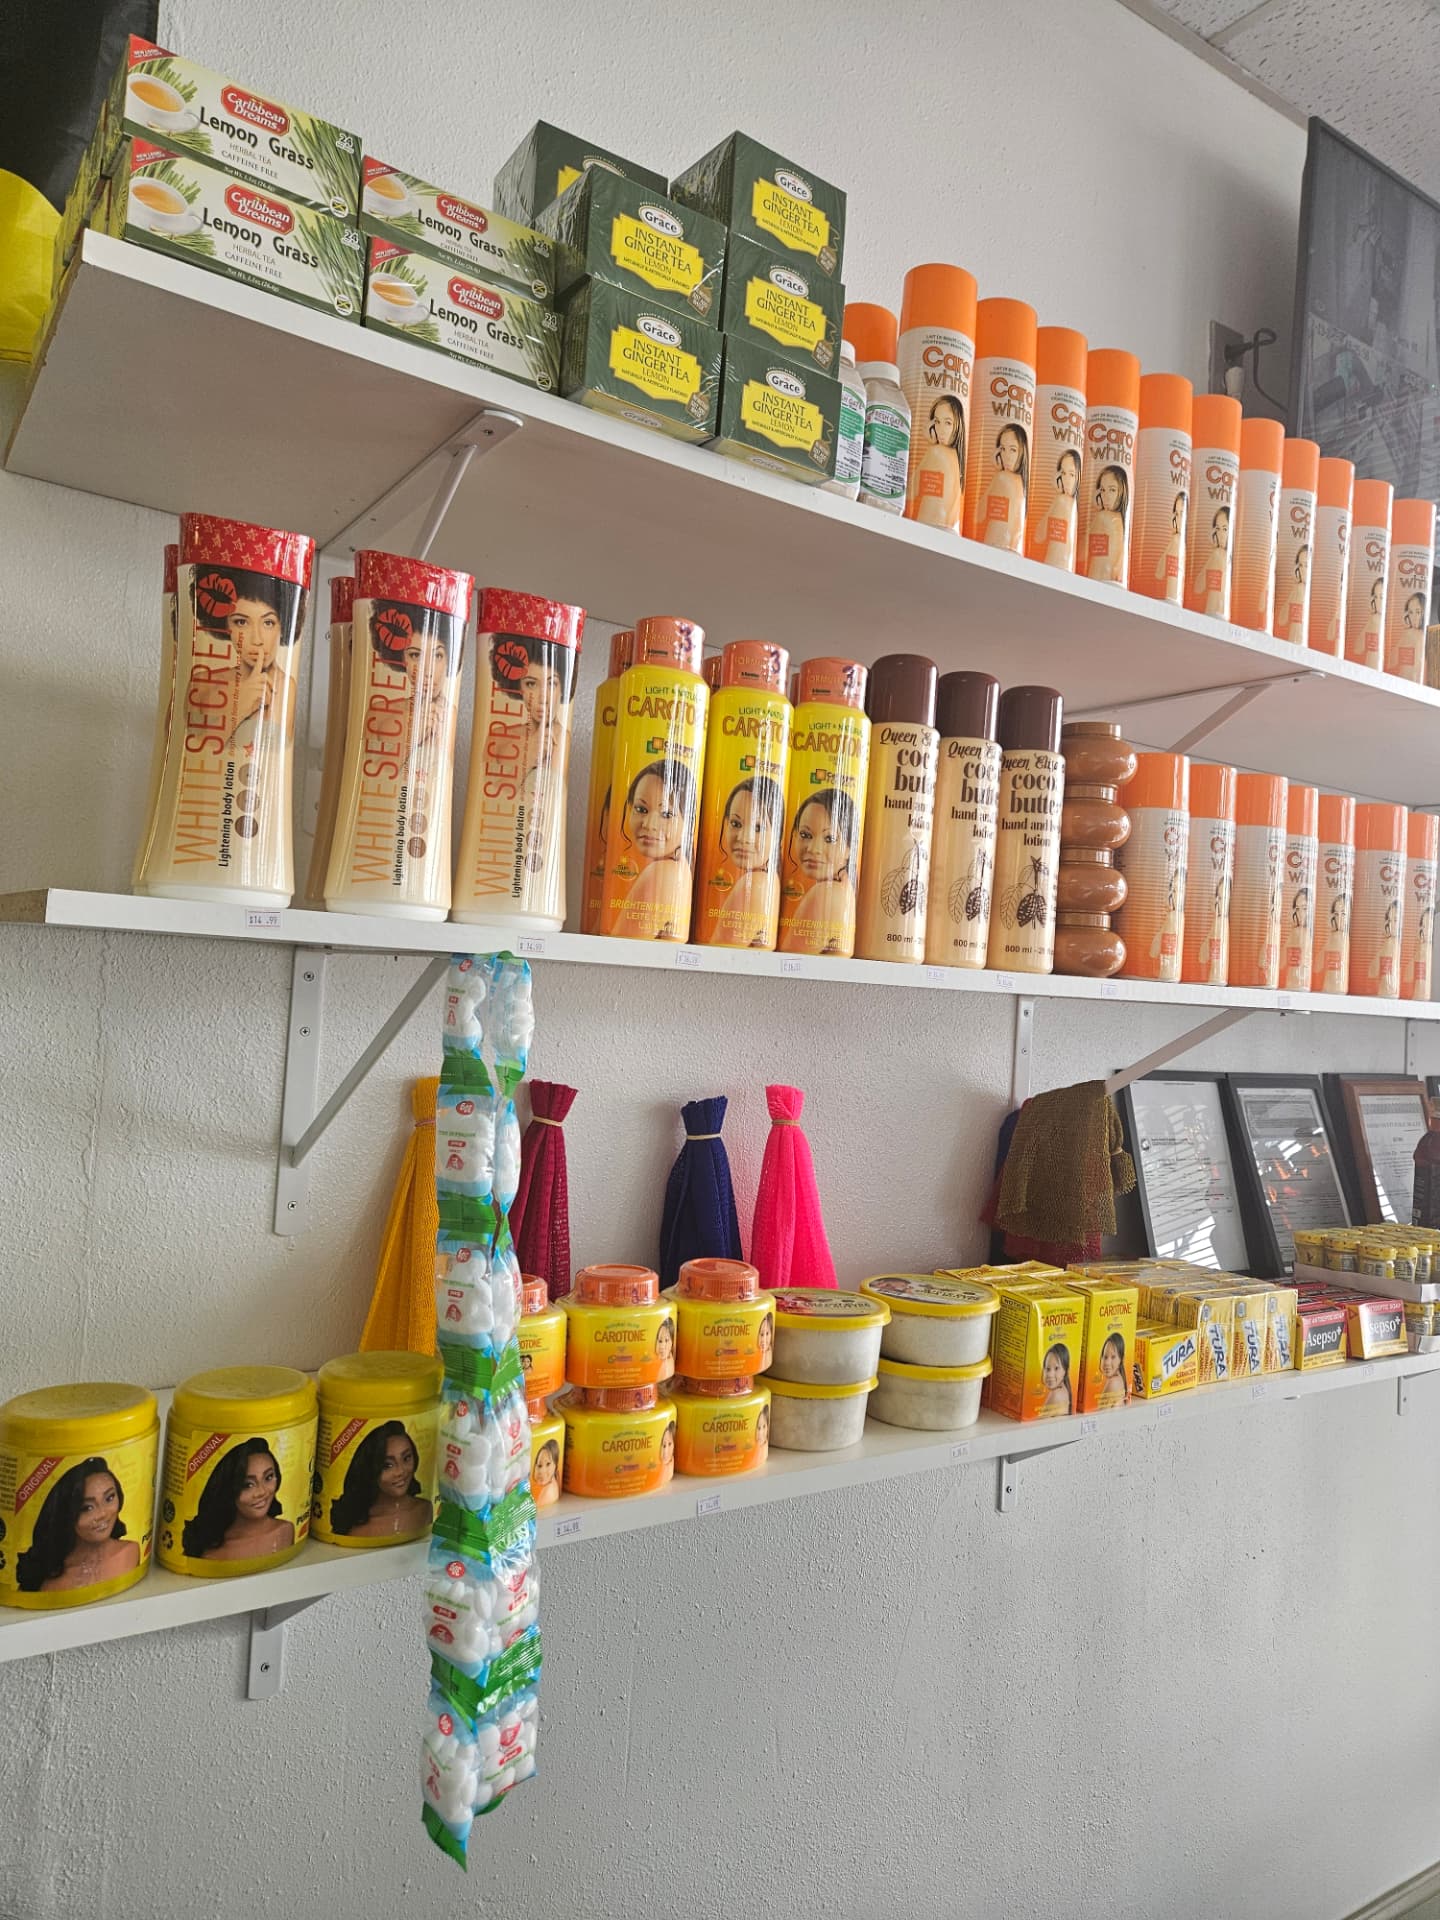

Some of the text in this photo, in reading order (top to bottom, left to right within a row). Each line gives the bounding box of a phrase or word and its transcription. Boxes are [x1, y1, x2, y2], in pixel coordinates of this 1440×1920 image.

[227, 92, 286, 125] Caribbean
[234, 103, 278, 130] Dreams
[200, 106, 314, 170] Lemon Grass
[780, 176, 807, 198] Grace
[231, 191, 290, 224] Caribbean
[237, 203, 282, 229] Dreams
[440, 199, 486, 223] Caribbean
[763, 199, 820, 237] GINGER TEA
[772, 191, 813, 220] INSTANT
[418, 208, 505, 258] Lemon Grass
[645, 211, 678, 233] Grace
[203, 207, 319, 269] Lemon Grass
[635, 227, 684, 258] INSTANT
[624, 235, 692, 275] GINGER TEA
[644, 256, 671, 275] LEMON
[452, 283, 501, 309] Caribbean
[775, 273, 804, 293] Grace
[757, 297, 816, 332] GINGER TEA
[766, 288, 809, 316] INSTANT
[430, 298, 524, 350] Lemon Grass
[643, 321, 676, 342] Grace
[774, 316, 798, 333] LEMON
[622, 347, 690, 384] GINGER TEA
[633, 338, 682, 367] INSTANT
[642, 367, 670, 385] LEMON
[771, 375, 800, 394] Grace
[923, 369, 968, 397] white
[752, 400, 813, 432] GINGER TEA
[762, 391, 807, 417] INSTANT
[992, 399, 1032, 426] white
[770, 418, 795, 433] LEMON
[1089, 443, 1132, 466] white
[645, 687, 669, 695] LIGHT
[738, 706, 761, 716] LIGHT
[808, 722, 831, 731] LIGHT
[880, 727, 918, 746] Queen
[948, 741, 982, 759] Queen
[218, 761, 235, 868] Lightening body lotion
[884, 795, 913, 810] hand
[951, 806, 977, 821] hand
[392, 785, 408, 887] Lightening body lotion
[1002, 818, 1028, 830] hand
[512, 805, 525, 899] Lightening body lotion
[886, 933, 903, 942] 800
[954, 938, 968, 947] 800
[1005, 945, 1020, 953] 800
[1100, 1303, 1132, 1317] CAROTONE
[594, 1329, 646, 1343] CAROTONE
[703, 1324, 752, 1337] CAROTONE
[1274, 1315, 1290, 1366] TURA
[1163, 1339, 1194, 1374] TURA
[1209, 1324, 1226, 1377] TURA
[1244, 1320, 1260, 1371] TURA
[332, 1417, 364, 1455] ORIGINAL
[703, 1418, 749, 1433] CAROTONE
[188, 1434, 225, 1472] ORIGINAL
[602, 1436, 653, 1453] CAROTONE
[18, 1459, 57, 1501] ORIGINAL
